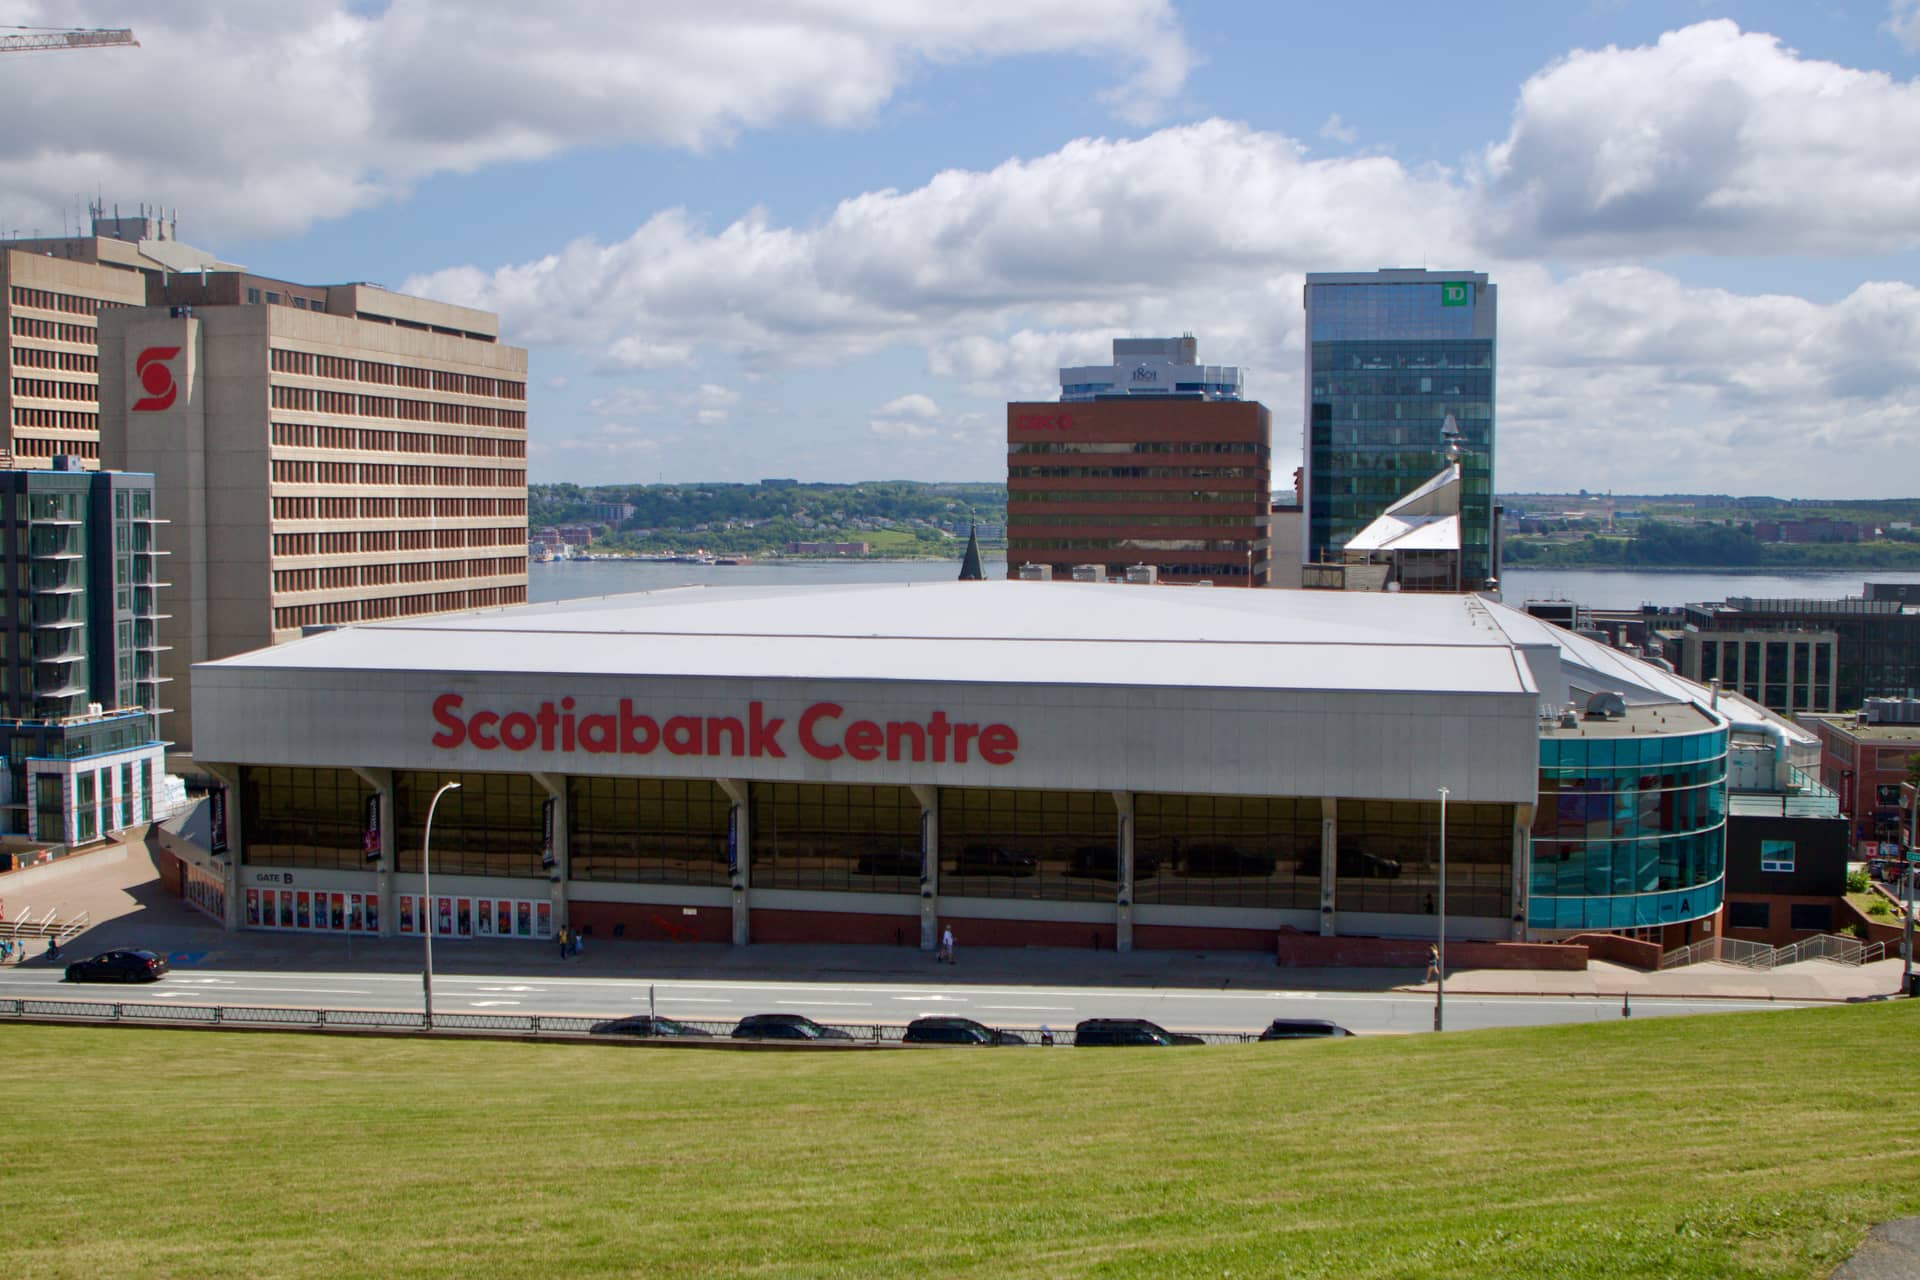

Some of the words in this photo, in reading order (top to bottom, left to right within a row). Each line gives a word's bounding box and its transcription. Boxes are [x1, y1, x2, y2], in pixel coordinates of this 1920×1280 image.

[1445, 287, 1465, 301] TD
[1132, 367, 1157, 381] 1801
[431, 693, 787, 758] Scotiabank
[797, 702, 1019, 765] Centre
[256, 873, 280, 881] GATE
[283, 873, 293, 884] B
[1680, 898, 1690, 913] A
